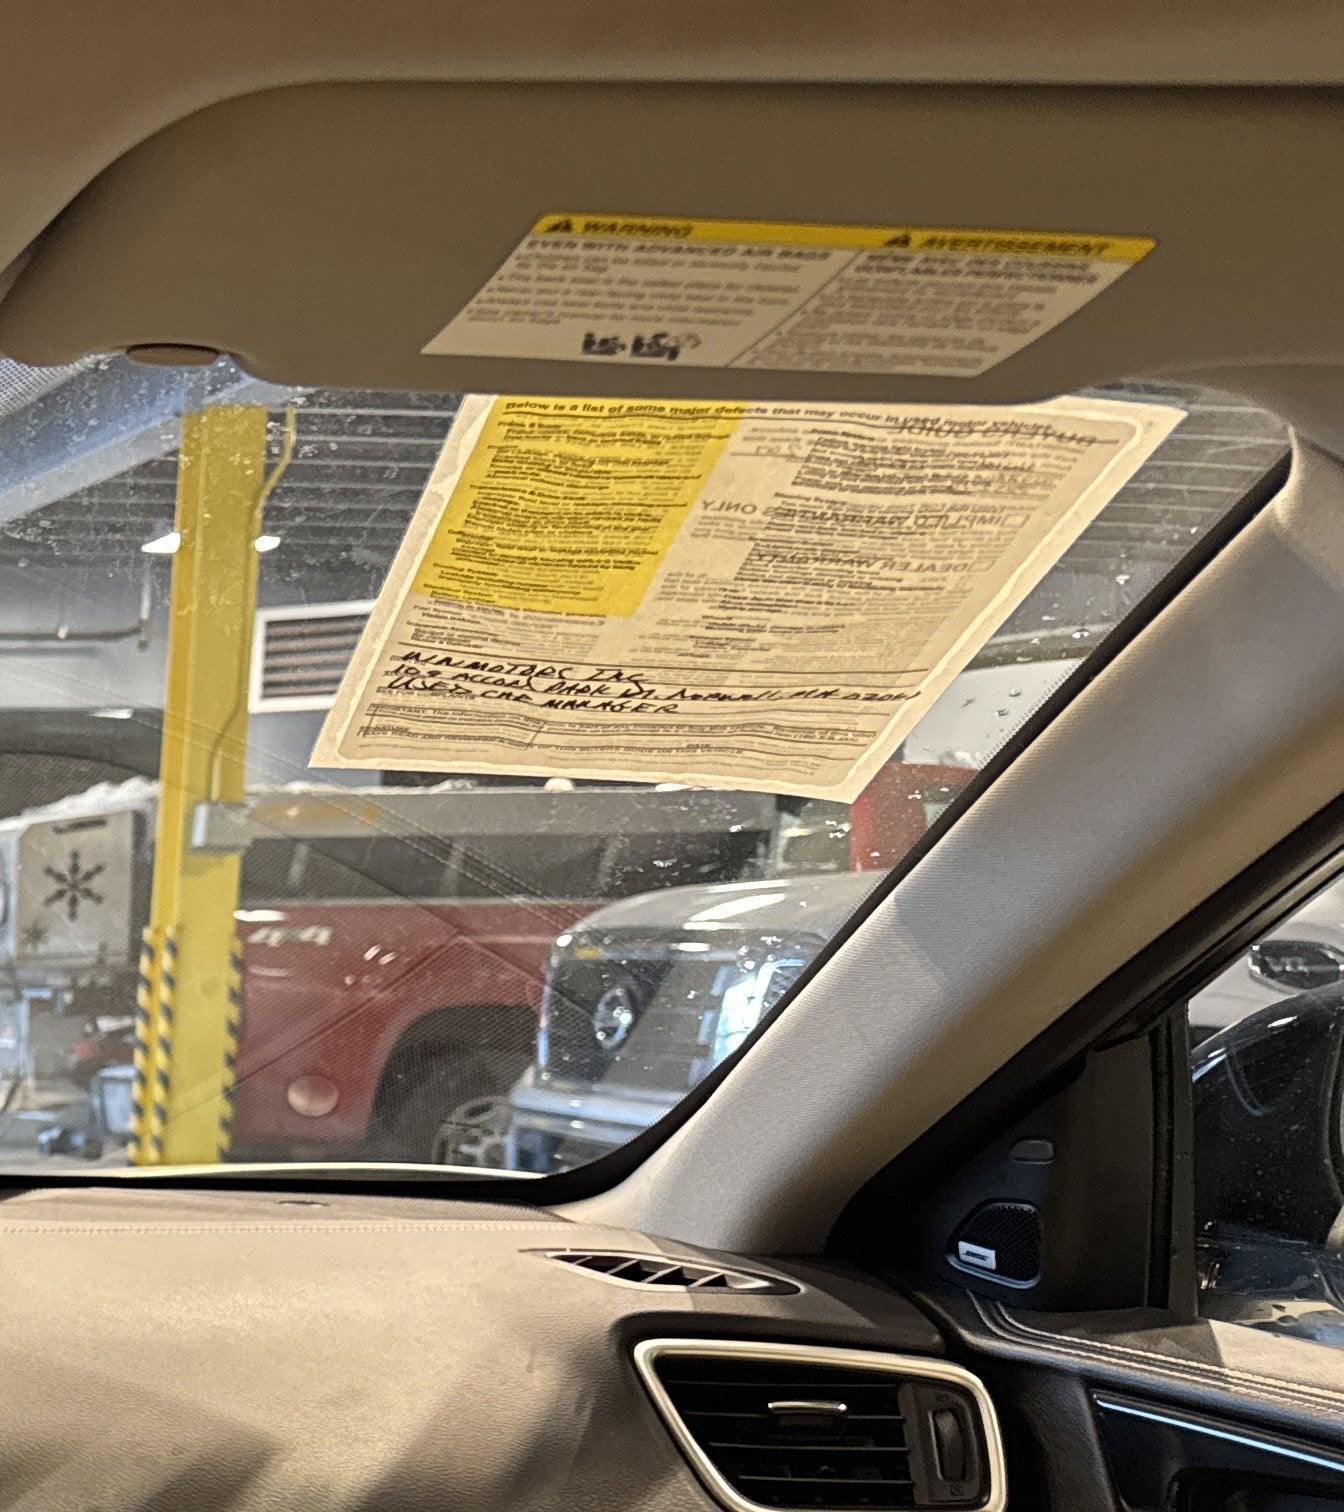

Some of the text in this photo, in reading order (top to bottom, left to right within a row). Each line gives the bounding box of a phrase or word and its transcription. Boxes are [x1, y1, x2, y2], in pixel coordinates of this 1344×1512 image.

[582, 221, 693, 239] WARNING
[506, 402, 549, 411] Below
[553, 402, 565, 411] is
[582, 403, 603, 413] list
[608, 404, 623, 415] of
[626, 405, 666, 414] some
[669, 405, 712, 417] major
[717, 406, 769, 415] defects
[772, 407, 801, 416] that
[804, 409, 834, 419] may
[839, 411, 882, 422] occur
[885, 413, 900, 423] in
[541, 698, 680, 713] MANAGER
